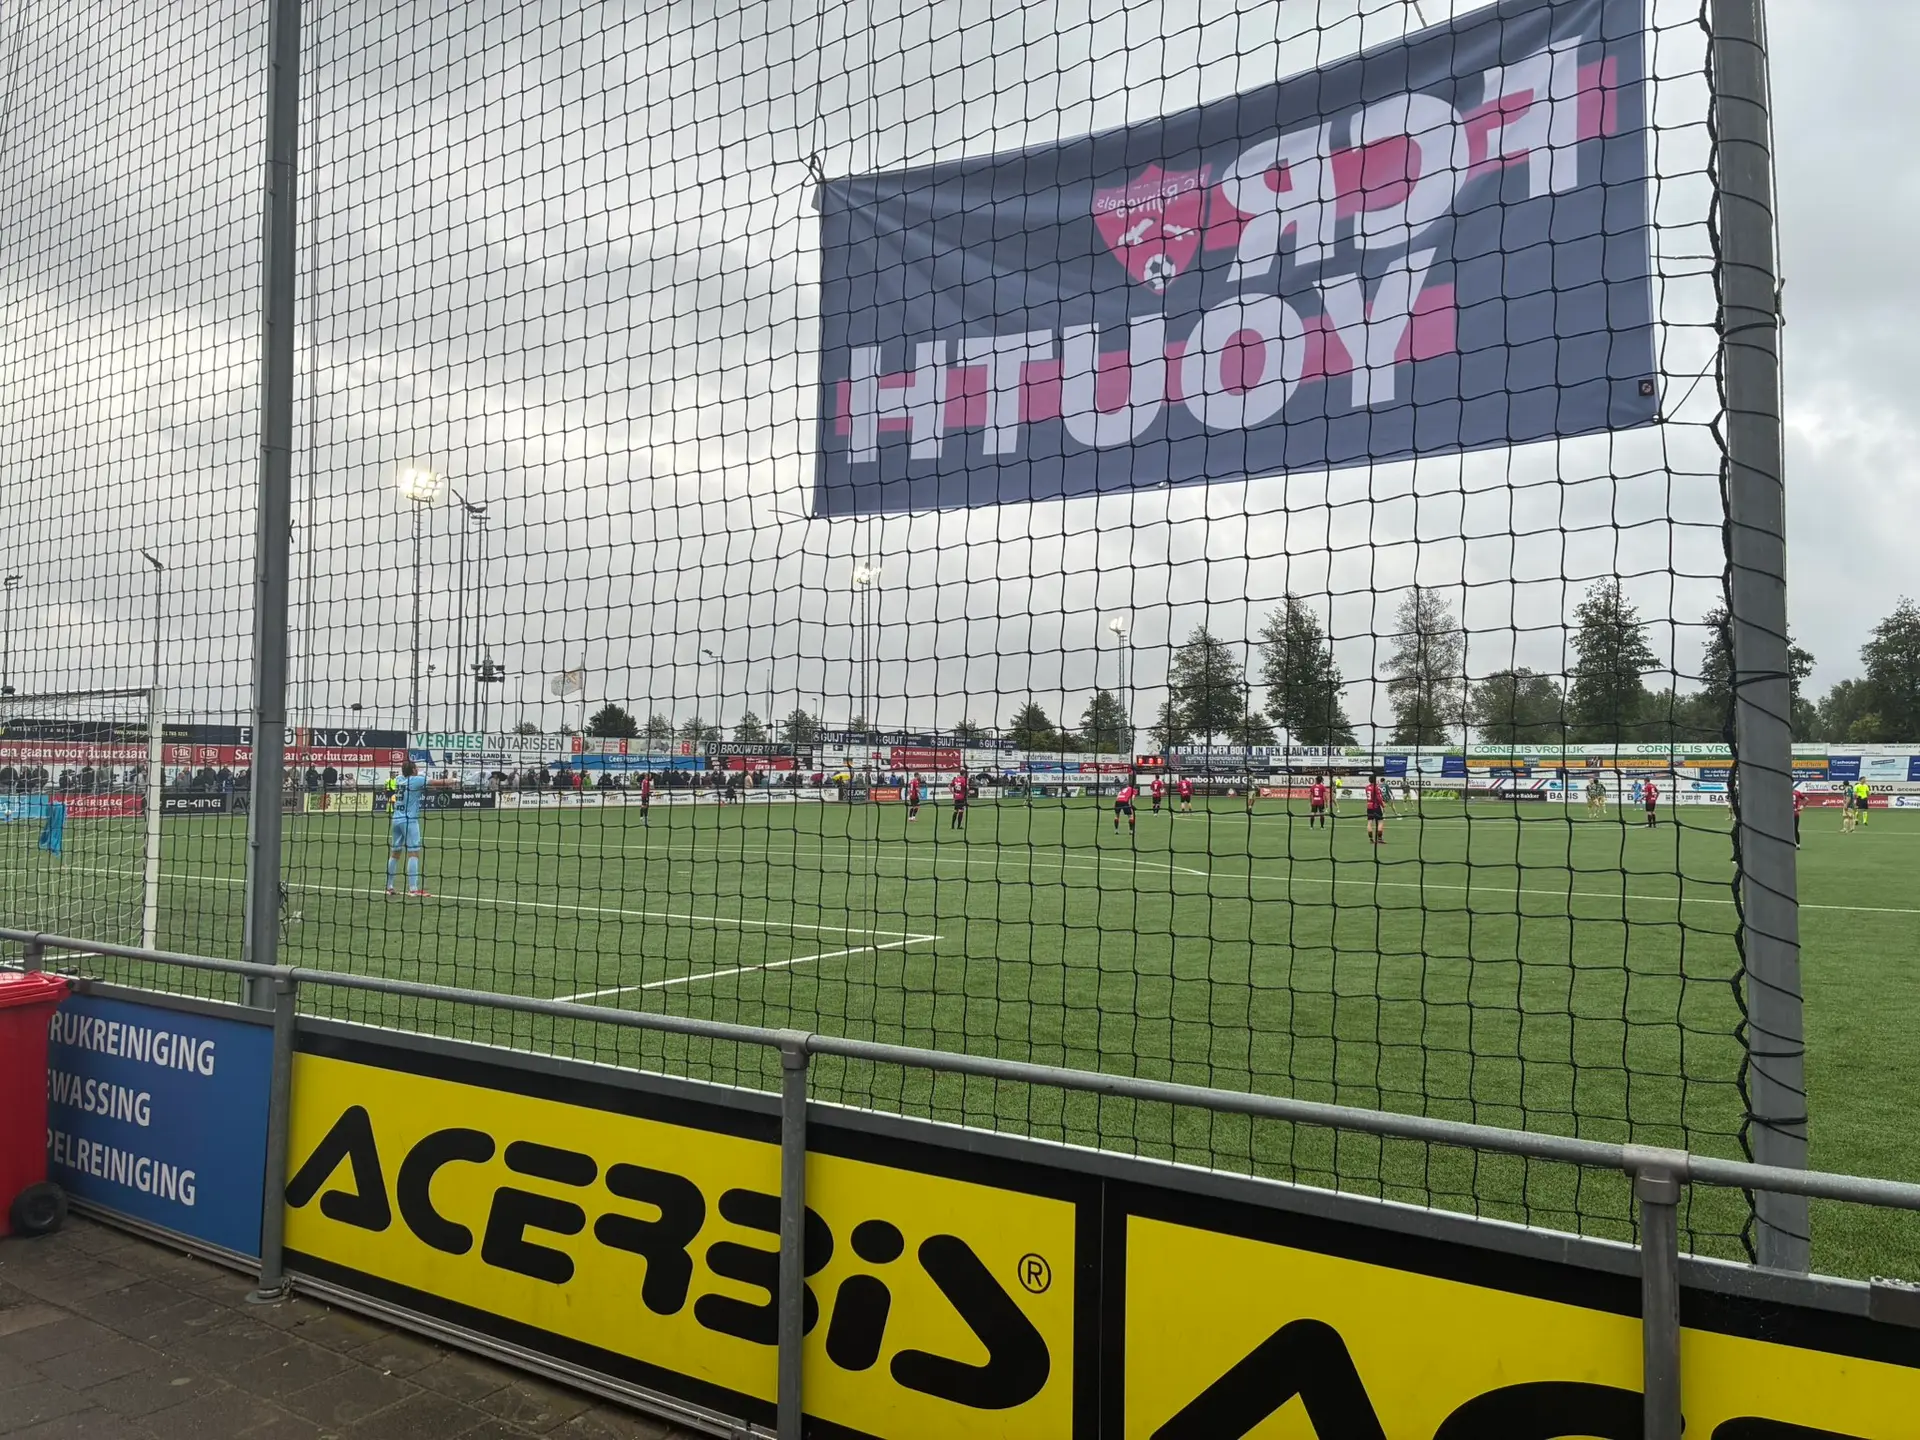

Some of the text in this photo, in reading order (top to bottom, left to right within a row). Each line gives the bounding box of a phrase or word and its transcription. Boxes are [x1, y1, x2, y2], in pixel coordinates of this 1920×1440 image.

[415, 733, 563, 751] VERHEES NOTARISSEN
[882, 735, 903, 745] GUIJT
[20, 747, 53, 760] gaan
[55, 747, 86, 758] voor
[720, 743, 764, 755] BROUWER
[1178, 746, 1191, 755] DEN
[1193, 746, 1228, 755] BLAUWEN
[1282, 746, 1320, 756] BLAUWEN
[1322, 746, 1342, 756] BCK
[1474, 745, 1585, 754] CORNELIS VROLIJK
[1637, 745, 1732, 753] CORNELIS VRO
[325, 750, 373, 761] duurzaam
[1184, 775, 1269, 785] amboo World Gana
[1386, 778, 1431, 786] conianza
[334, 794, 368, 806] Kralt
[1549, 793, 1579, 801] BAIS
[463, 800, 481, 808] Africa
[48, 1010, 216, 1077] RUKREINIGING
[48, 1069, 151, 1128] WASSING
